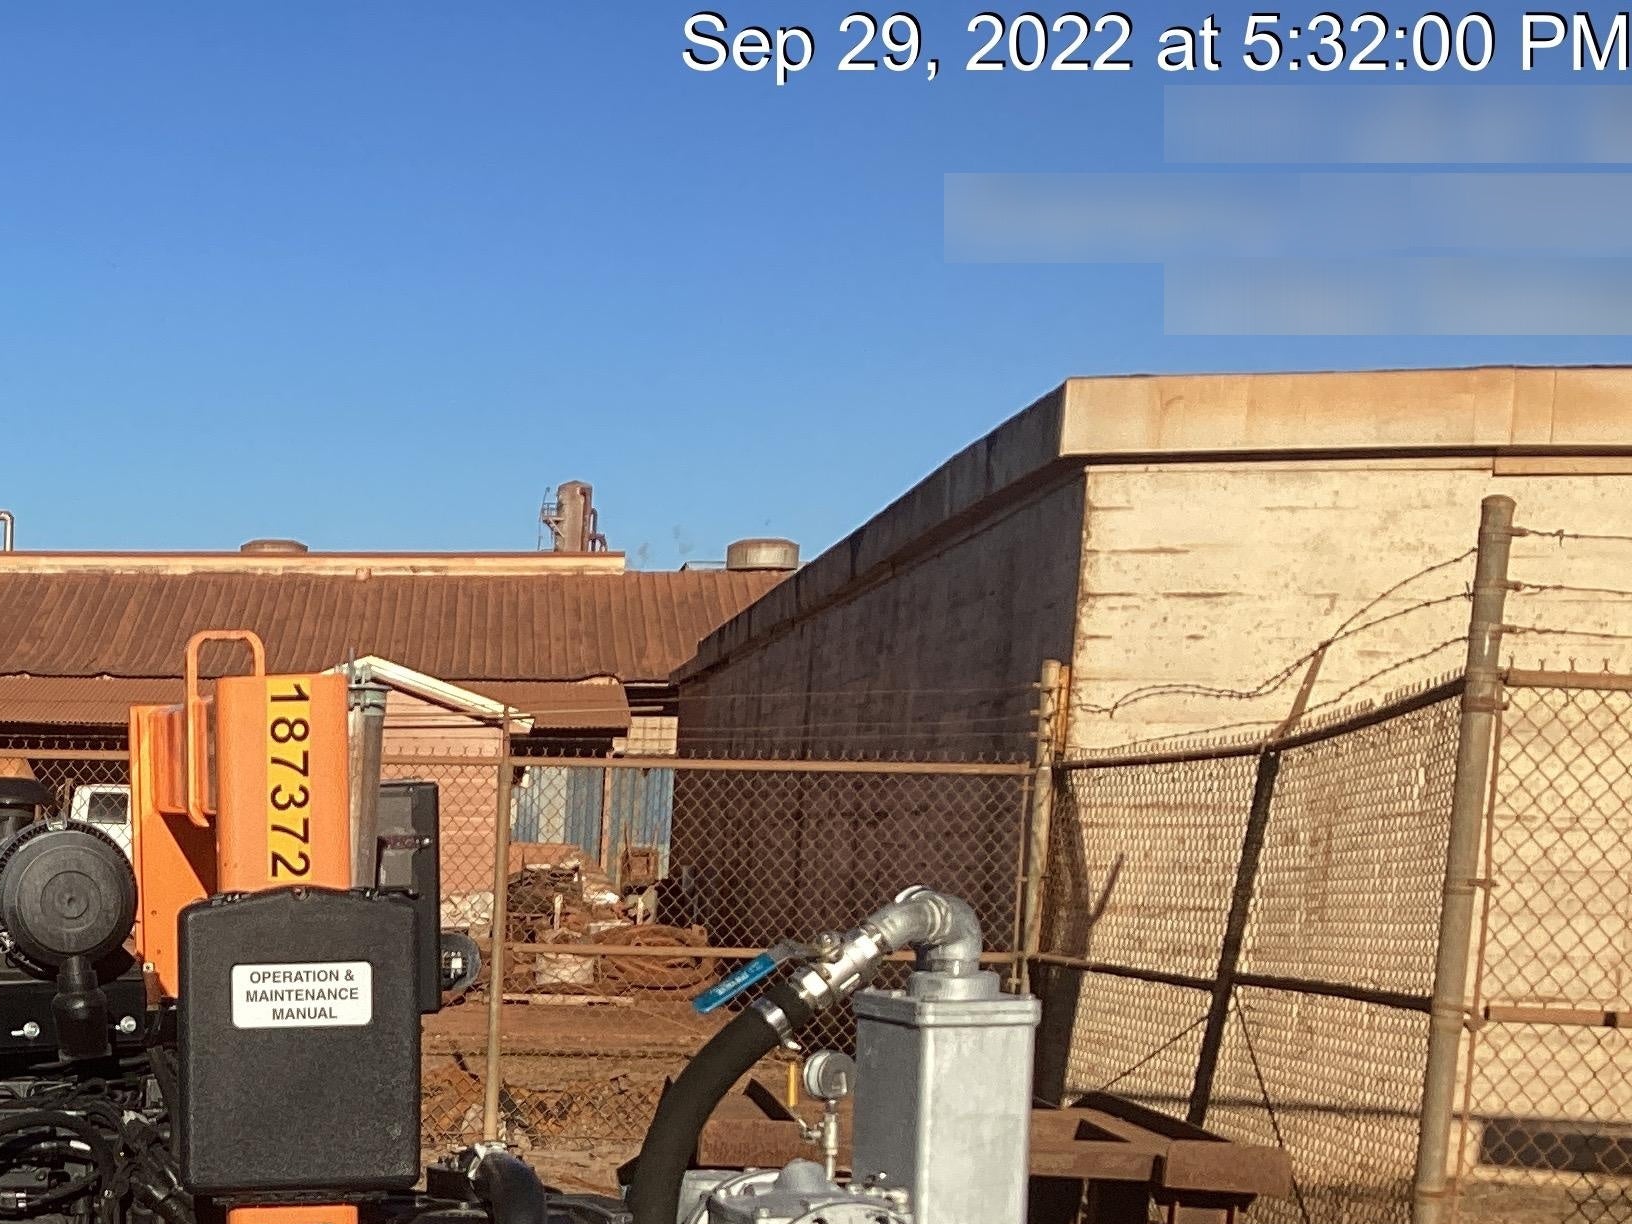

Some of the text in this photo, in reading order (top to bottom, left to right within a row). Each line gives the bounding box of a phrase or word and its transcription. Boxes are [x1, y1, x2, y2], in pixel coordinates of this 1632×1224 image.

[270, 683, 310, 877] 187372
[249, 968, 355, 984] OPERATION &
[245, 987, 359, 1003] MAINTENANCE
[271, 1006, 338, 1020] MANUAL
